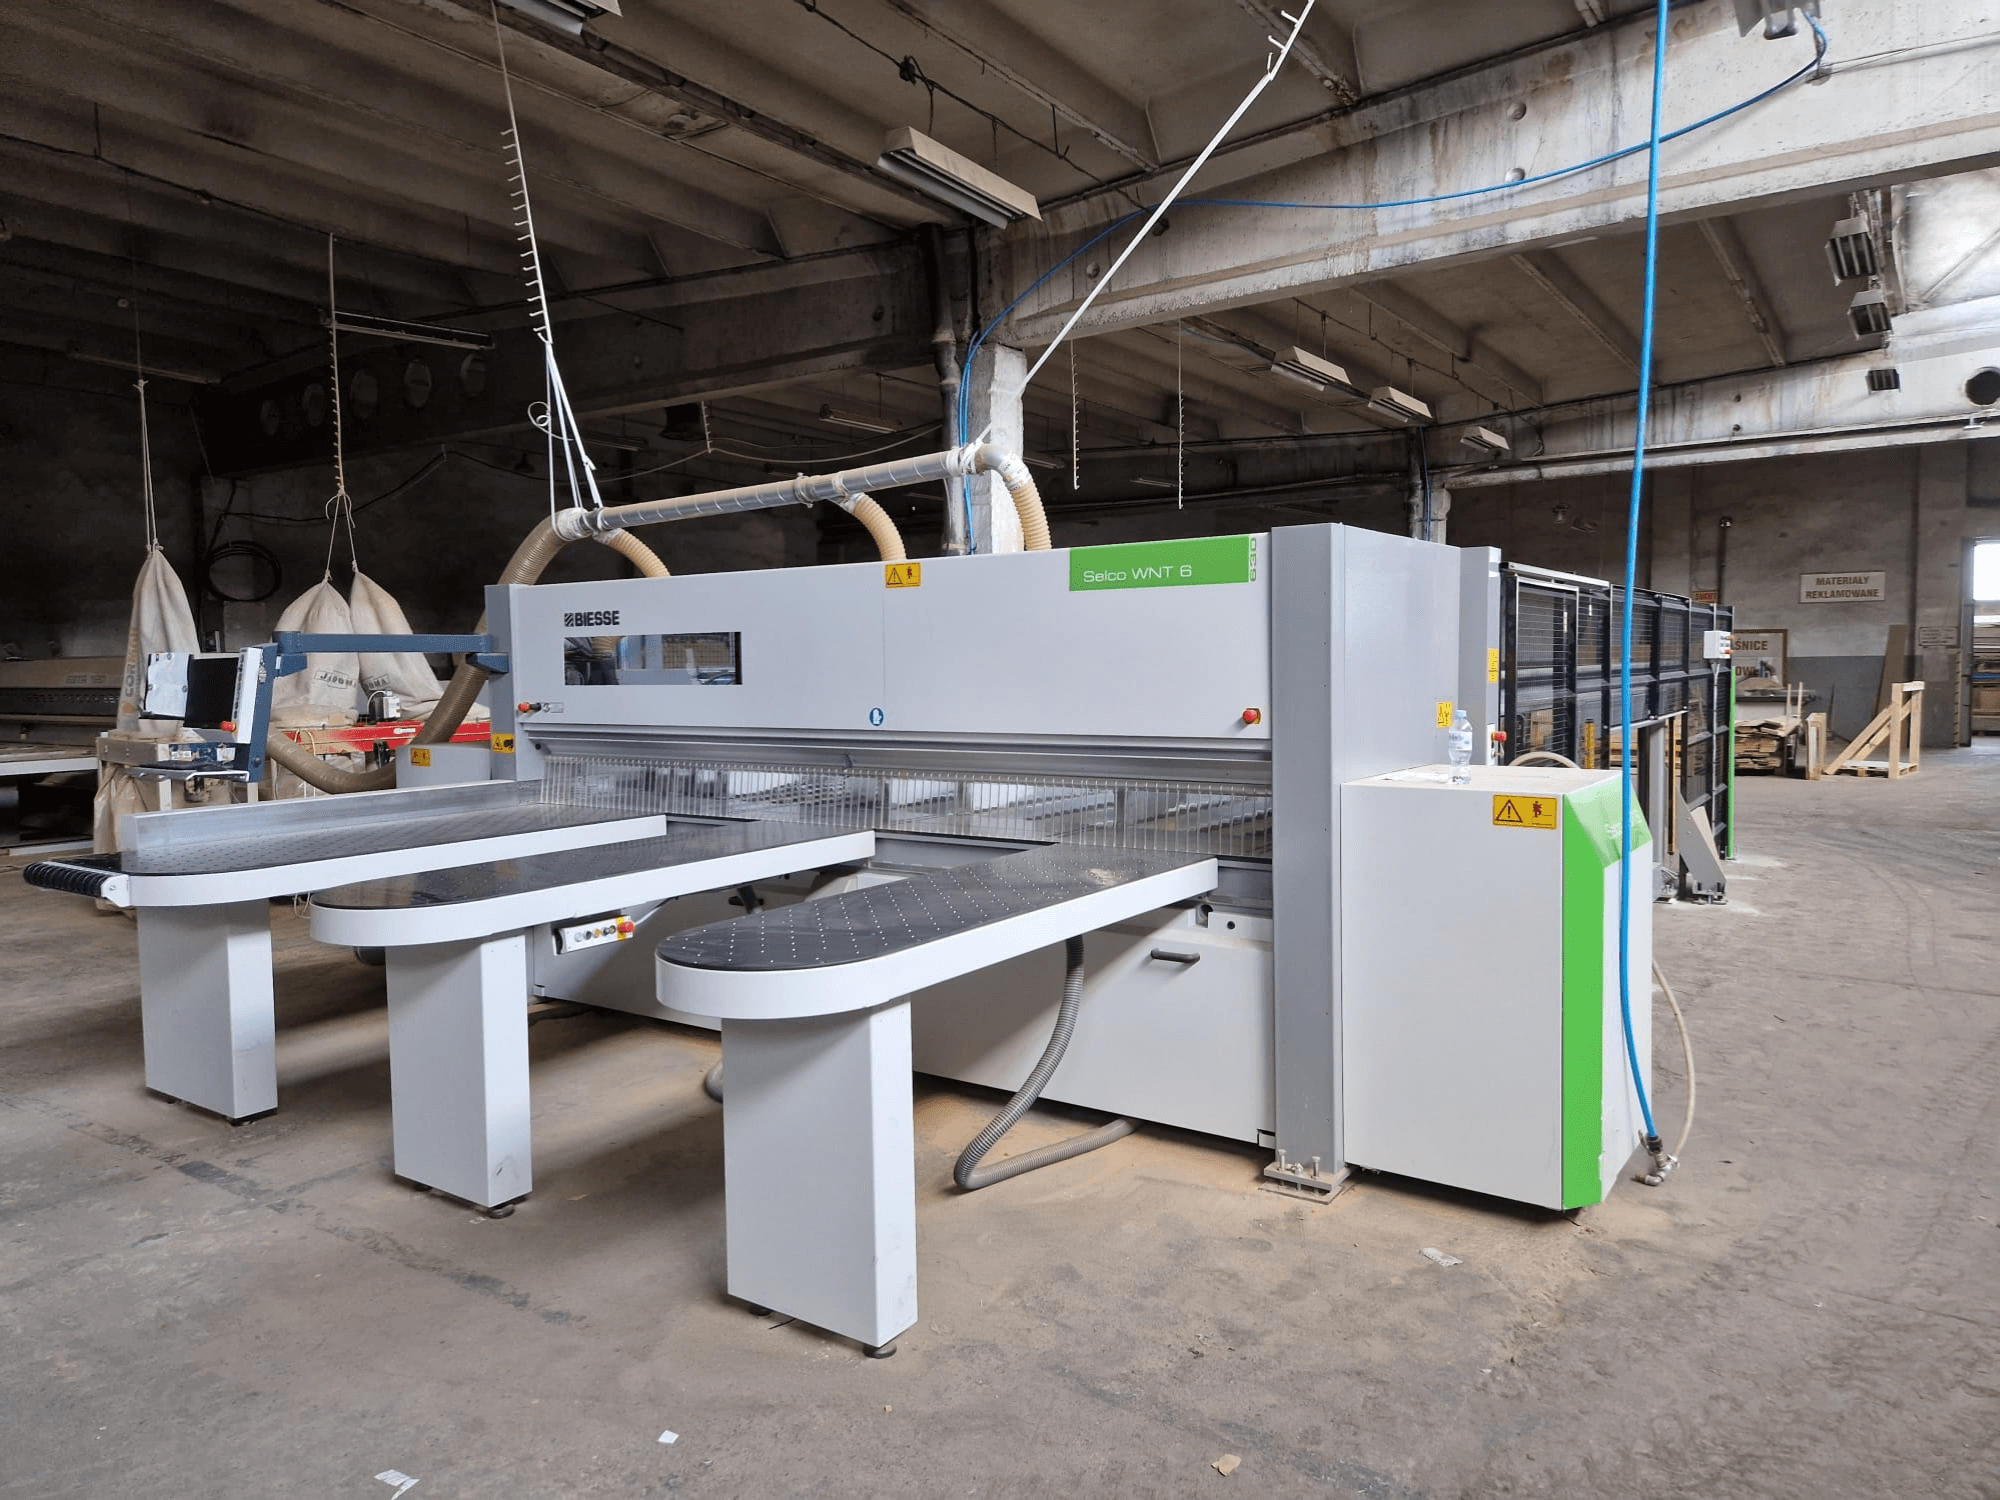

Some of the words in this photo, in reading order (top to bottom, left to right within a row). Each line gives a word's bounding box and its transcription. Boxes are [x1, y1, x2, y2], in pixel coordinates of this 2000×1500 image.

[1083, 570, 1127, 583] Selco
[1131, 566, 1174, 579] WNT
[1180, 564, 1193, 578] 6
[1806, 588, 1880, 599] REKLAMOWANE
[575, 610, 620, 627] BIESSE
